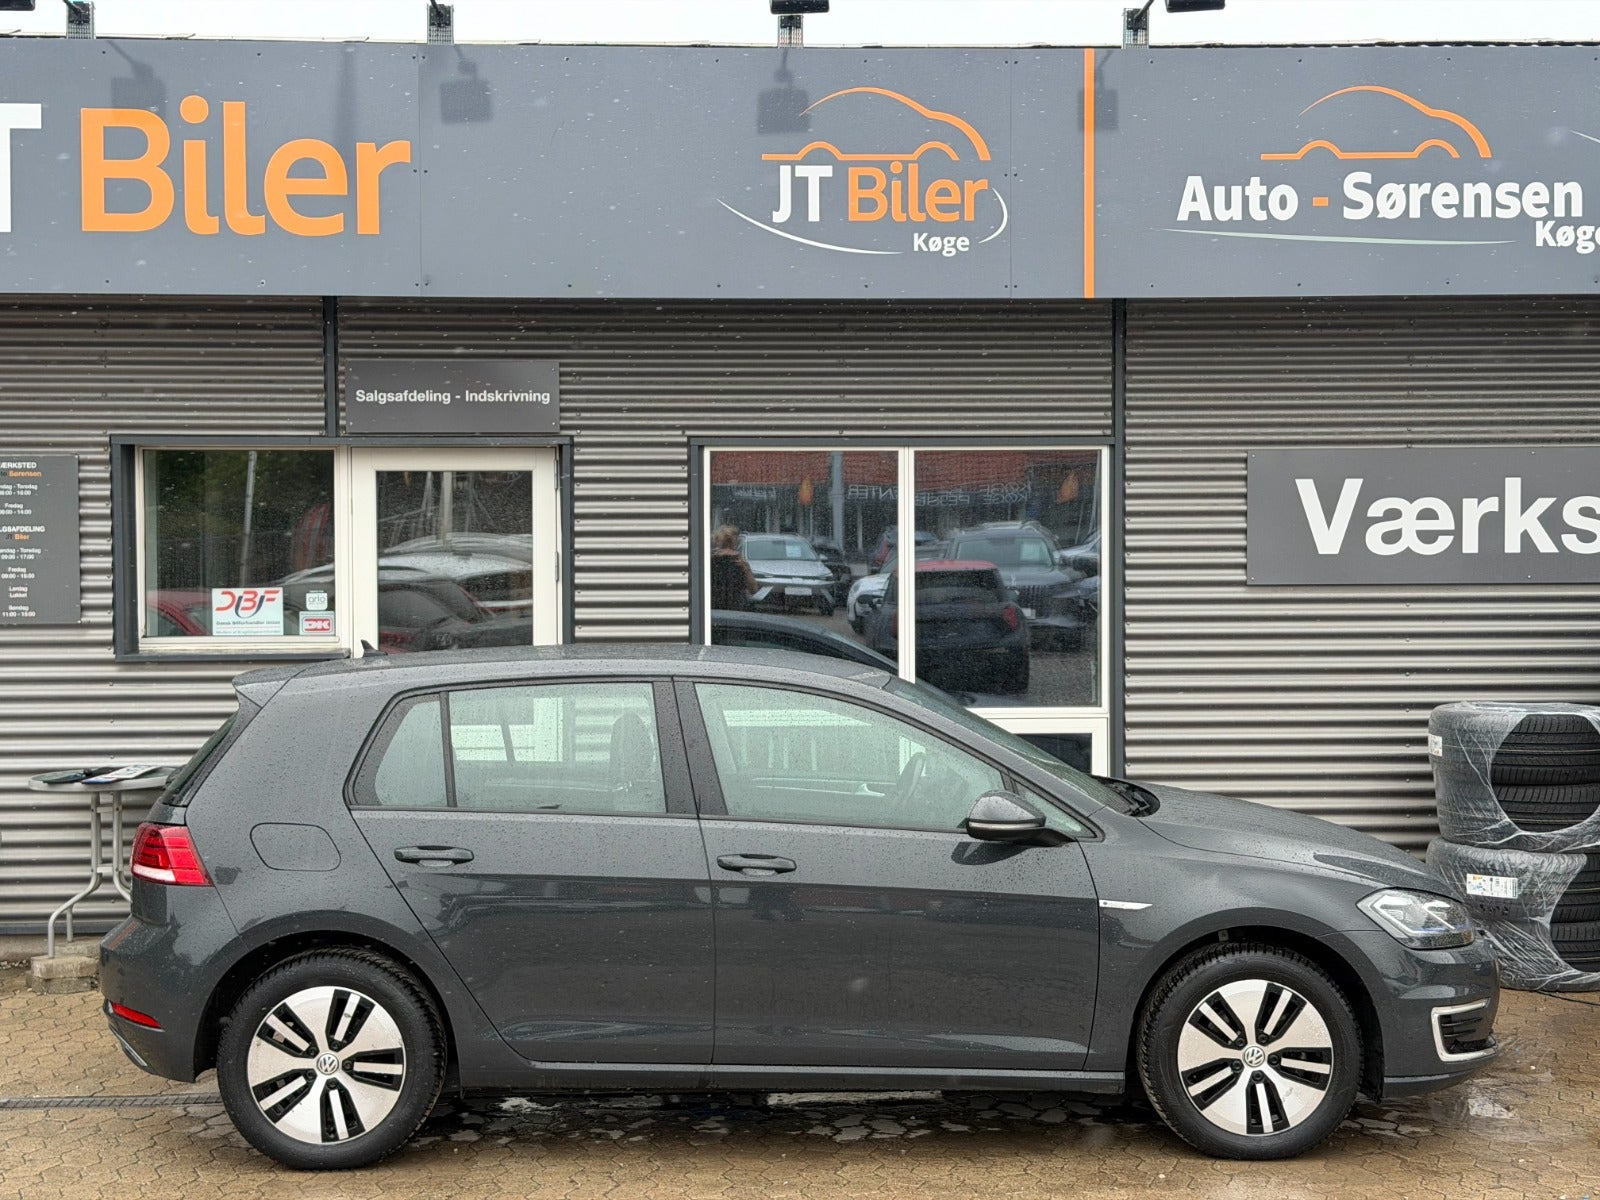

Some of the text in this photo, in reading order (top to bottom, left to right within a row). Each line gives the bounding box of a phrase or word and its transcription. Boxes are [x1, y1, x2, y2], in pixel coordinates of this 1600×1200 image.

[81, 95, 411, 236] Biler
[772, 161, 988, 223] JT Biler
[1176, 175, 1298, 221] Auto
[1343, 171, 1583, 220] Sørensen
[913, 232, 970, 257] Køge
[356, 390, 451, 404] Salgsafdeling
[465, 390, 550, 404] Indskrivning
[1295, 477, 1600, 556] Værks
